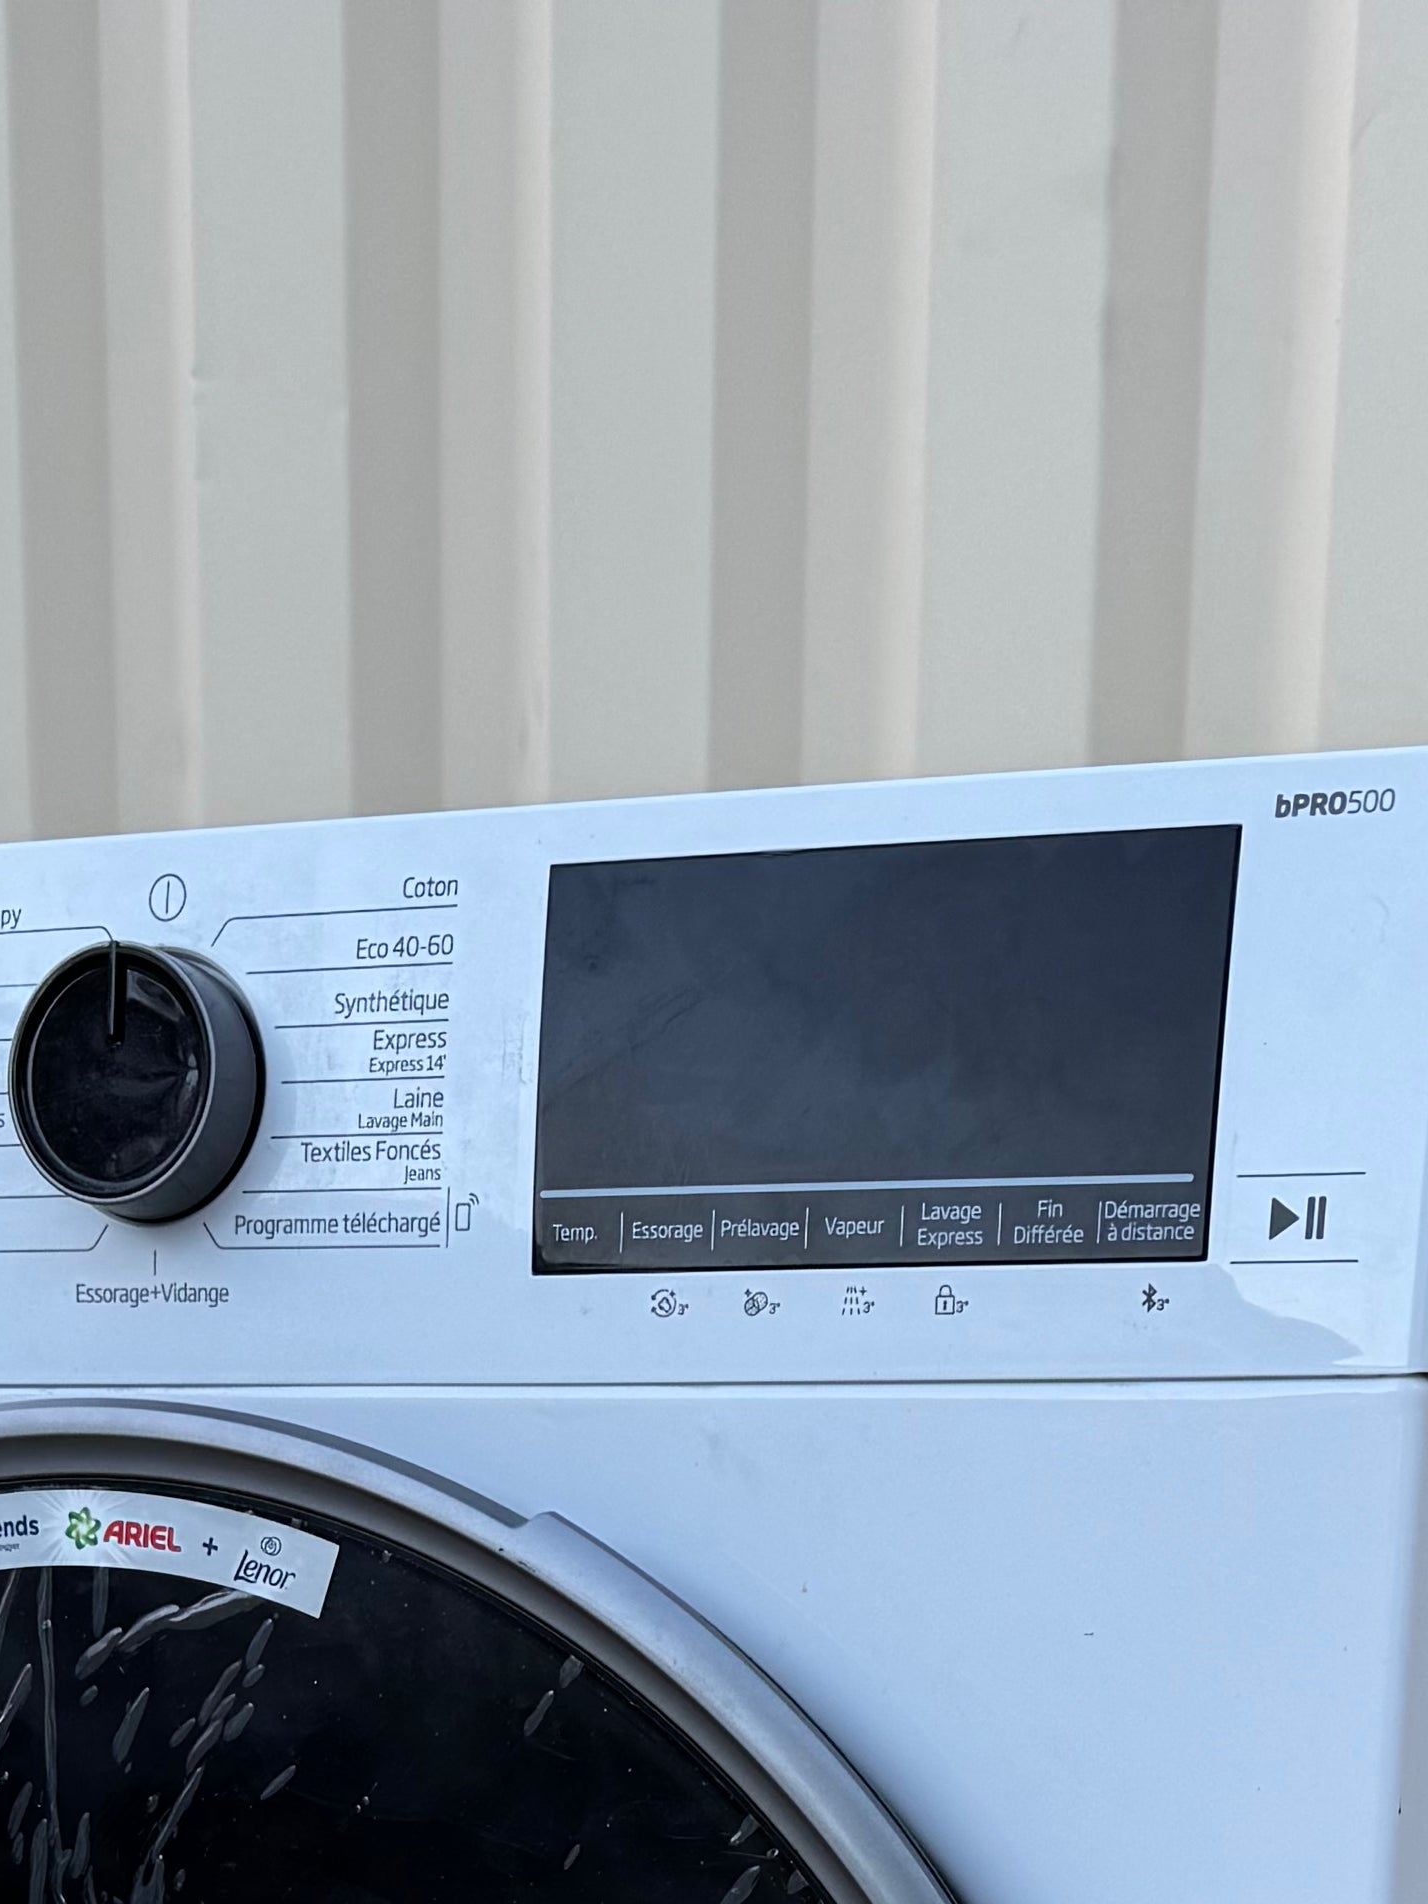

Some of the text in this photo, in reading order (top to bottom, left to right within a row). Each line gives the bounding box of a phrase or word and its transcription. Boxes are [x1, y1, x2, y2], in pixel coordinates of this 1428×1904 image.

[1274, 788, 1396, 819] bPRO500
[402, 876, 459, 899] Coton
[356, 933, 454, 960] Eco 40-60
[334, 988, 450, 1018] Synthétique
[373, 1029, 448, 1055] Express
[368, 1057, 423, 1076] Express
[393, 1086, 444, 1109] Laine
[358, 1110, 444, 1132] Lavage Main
[300, 1138, 441, 1163] Textiles Foncés
[404, 1165, 441, 1183] Jeans
[921, 1202, 982, 1225] Lavage
[1037, 1199, 1063, 1218] Fin
[1104, 1200, 1201, 1222] Démarrage
[234, 1210, 441, 1240] Programme téléchargé
[552, 1223, 598, 1244] Temp.
[632, 1221, 704, 1243] Essorage
[720, 1218, 800, 1241] Prélavage
[824, 1216, 885, 1239] Vapeur
[1013, 1224, 1084, 1245] Différée
[1107, 1220, 1195, 1242] à distance
[917, 1227, 983, 1250] Express
[75, 1281, 230, 1309] Essorage+Vidange
[103, 1519, 182, 1553] ARIEL
[233, 1548, 297, 1590] Lenor
